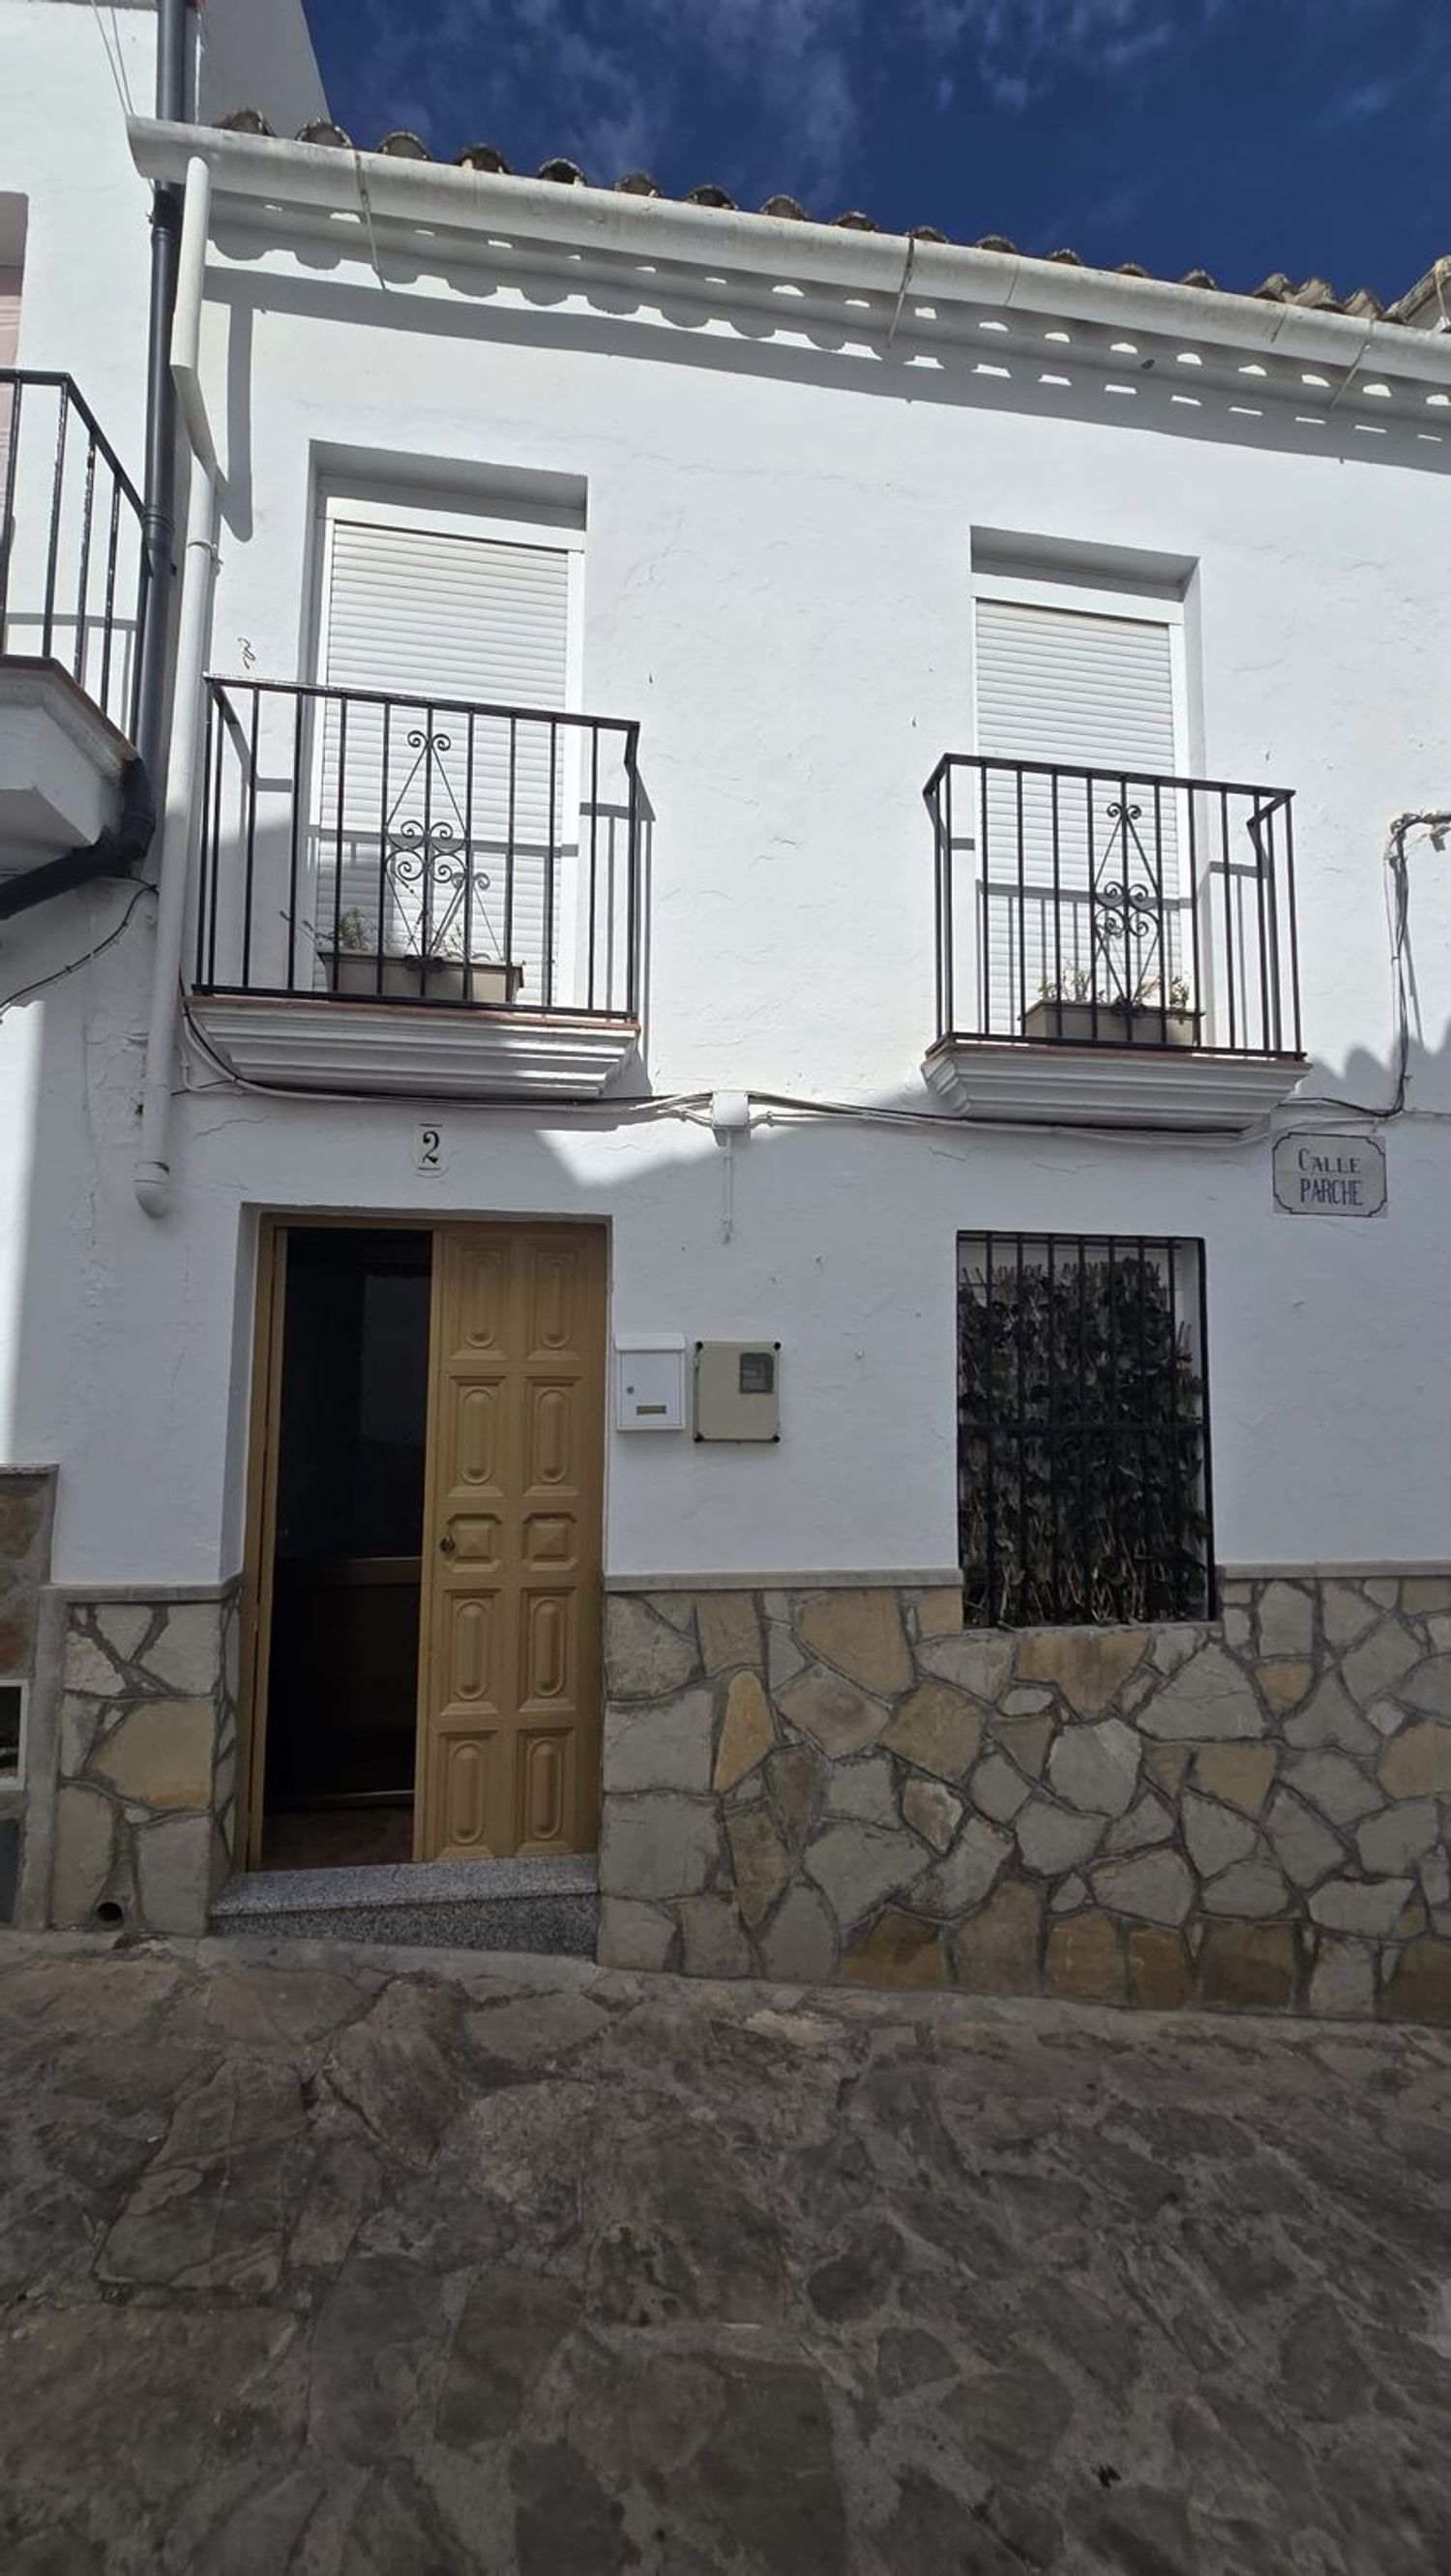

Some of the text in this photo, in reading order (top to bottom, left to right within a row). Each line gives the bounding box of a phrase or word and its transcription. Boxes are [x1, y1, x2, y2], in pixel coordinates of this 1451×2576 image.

[422, 1131, 439, 1164] 2
[1297, 1147, 1361, 1174] CALLE
[1300, 1177, 1363, 1206] PARCHE
